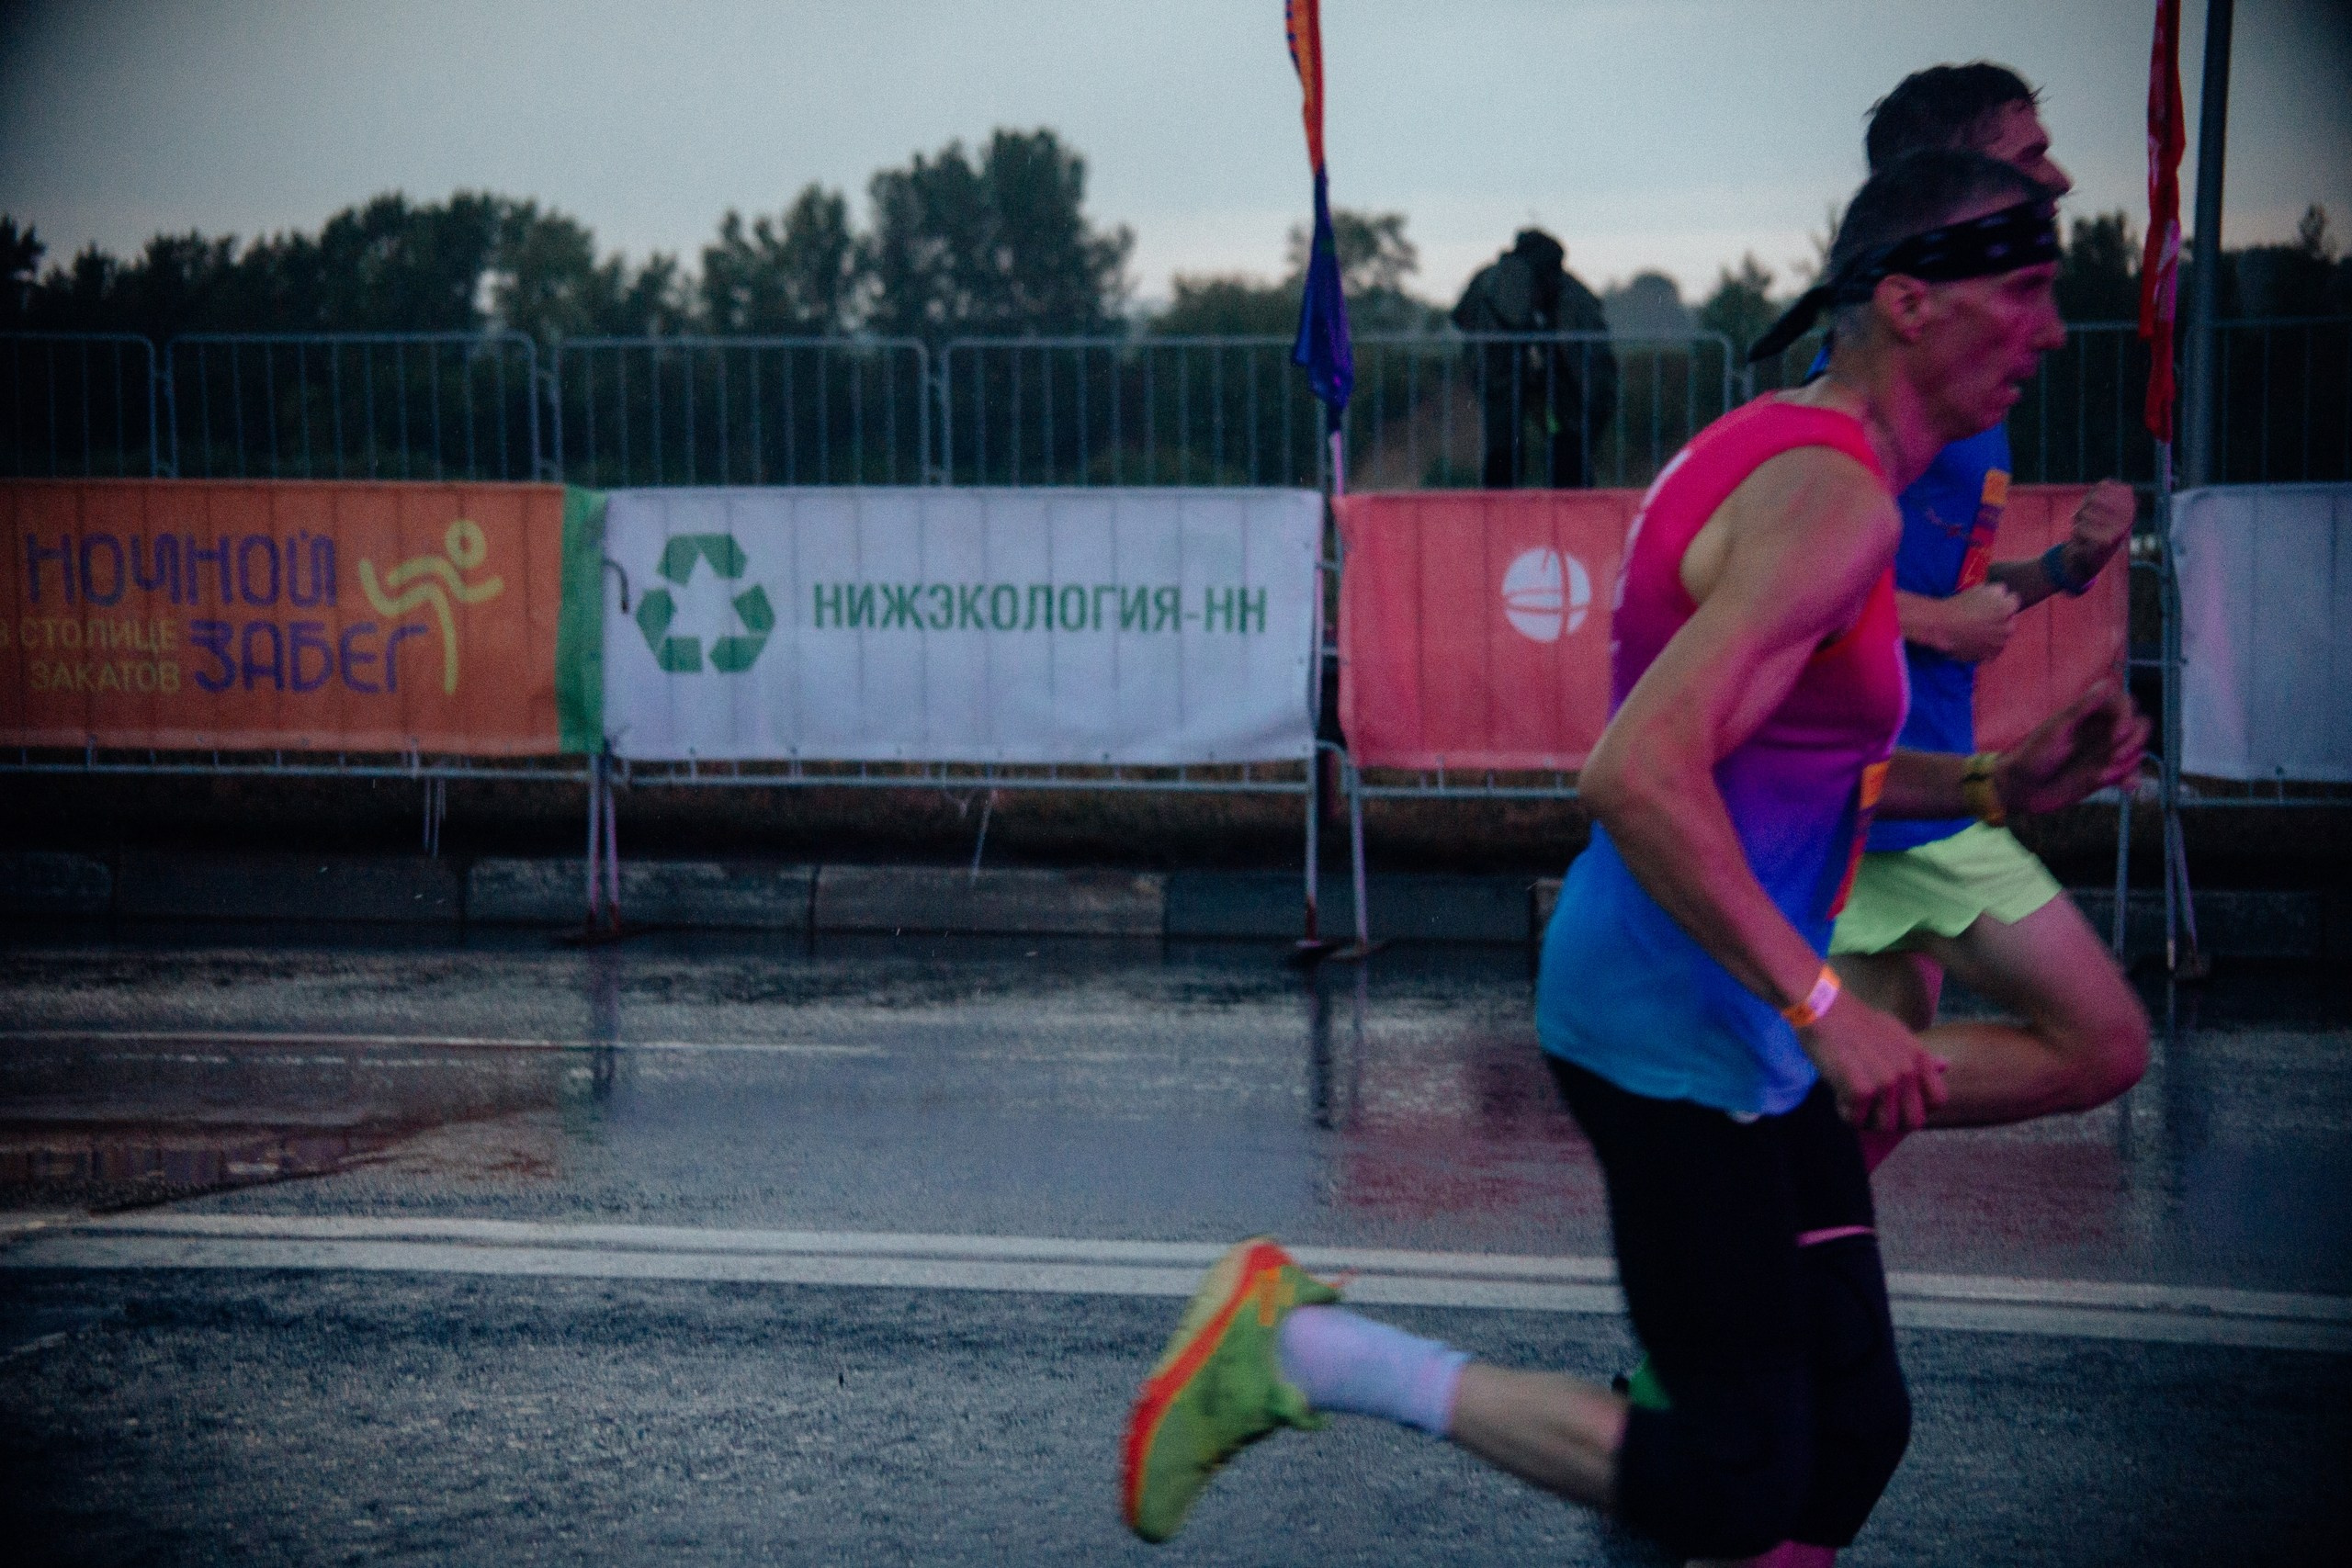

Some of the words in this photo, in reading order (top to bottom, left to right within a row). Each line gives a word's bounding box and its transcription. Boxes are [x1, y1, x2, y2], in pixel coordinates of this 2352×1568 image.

[26, 530, 338, 608] НОЧНОЙ
[813, 582, 1268, 634] НИЖЭКОЛОГИЯ-НН
[19, 617, 178, 655] СТОЛИЦЕ
[191, 619, 428, 694] ЗАБЕГ
[29, 660, 181, 694] ЗАКАТОВ
